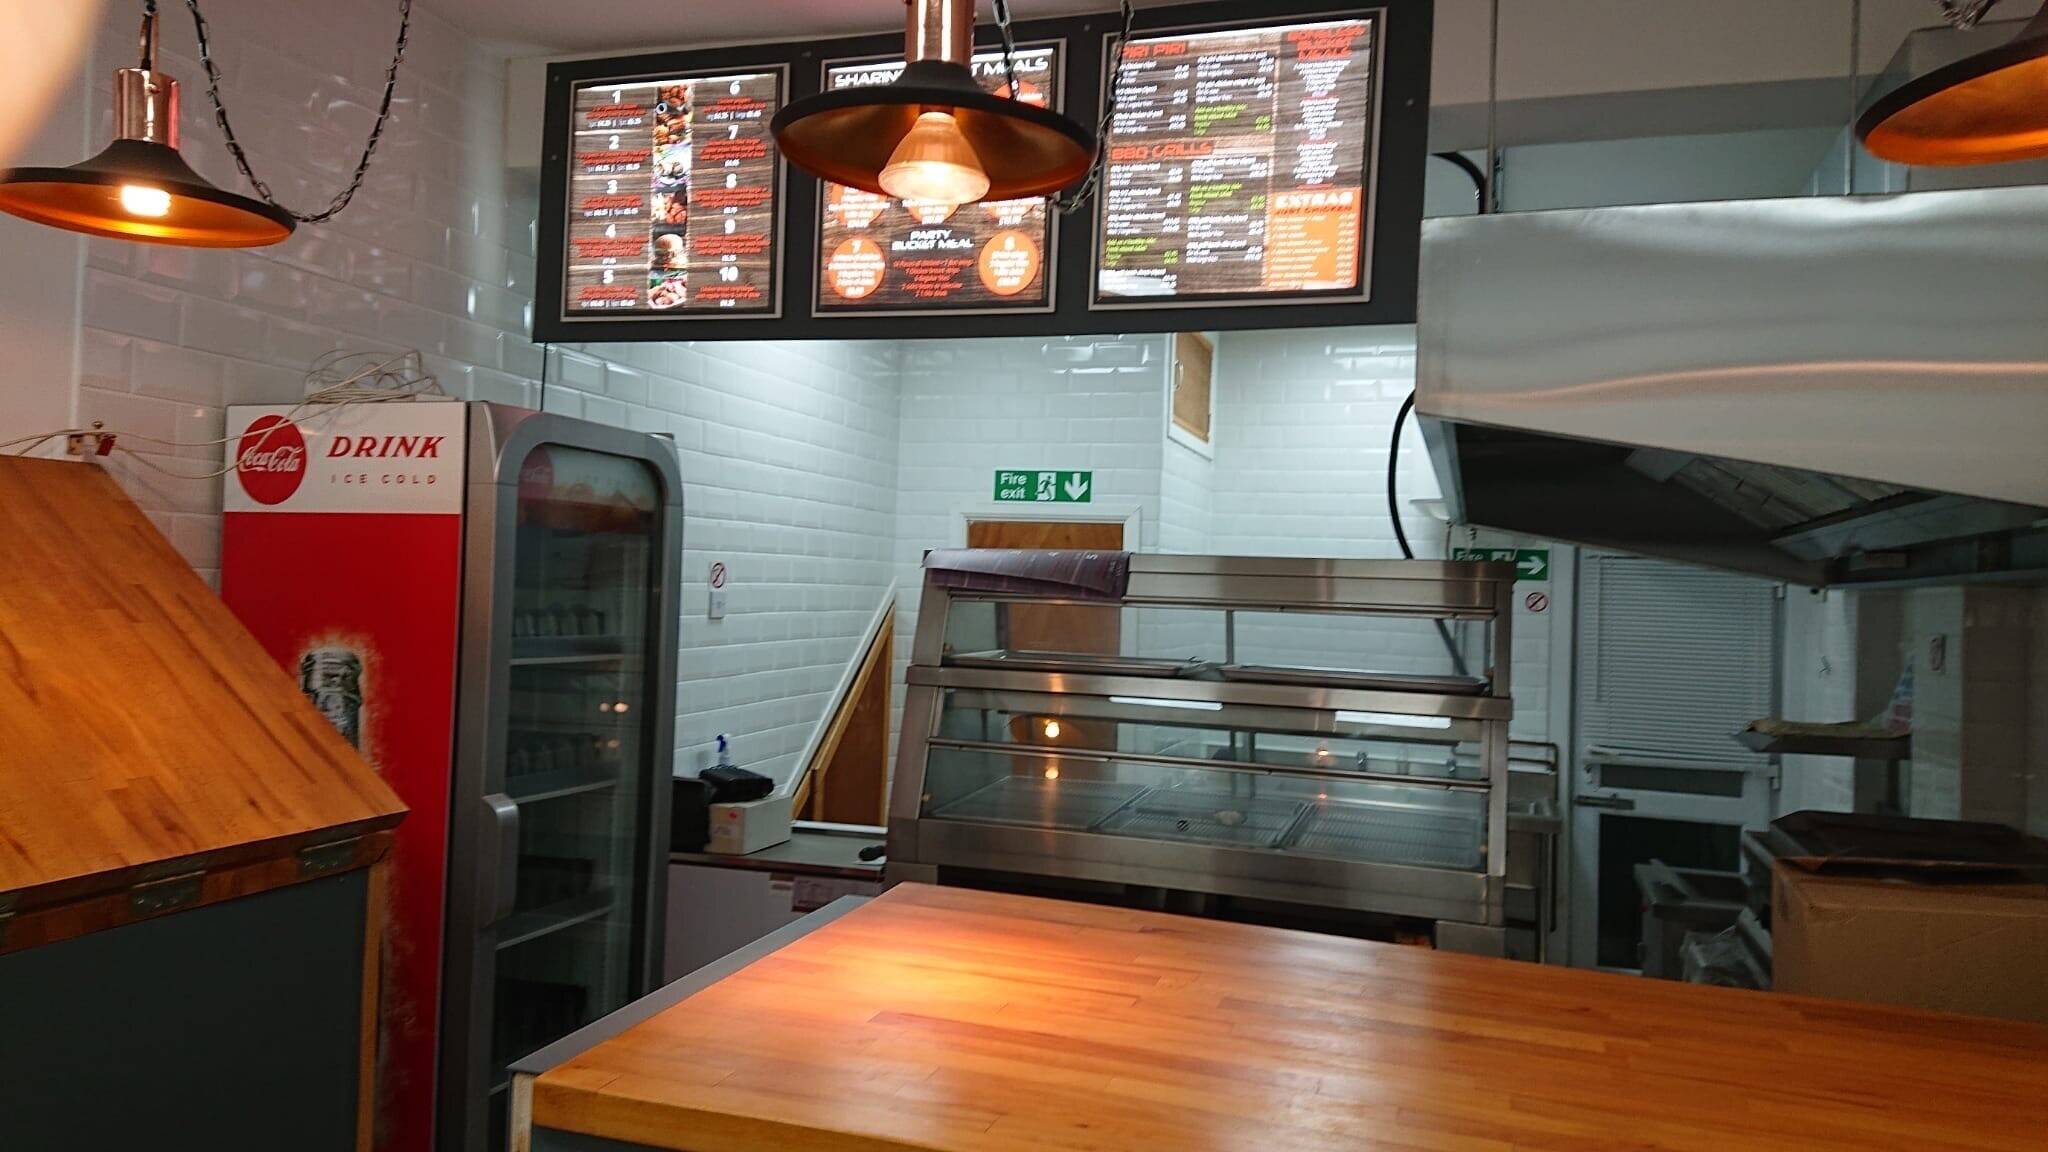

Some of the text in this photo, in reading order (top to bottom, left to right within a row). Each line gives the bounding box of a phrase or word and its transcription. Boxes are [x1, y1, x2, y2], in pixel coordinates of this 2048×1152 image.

[1154, 43, 1185, 55] PIRI
[834, 69, 904, 88] SHARIN
[730, 80, 741, 95] 6
[612, 90, 621, 103] 1
[728, 124, 739, 139] 7
[609, 136, 619, 150] 2
[1152, 142, 1213, 158] GRILLS
[607, 180, 618, 194] 3
[726, 173, 737, 188] 8
[1275, 192, 1354, 208] EXTRAS
[605, 223, 616, 238] 4
[725, 219, 736, 234] 9
[910, 230, 952, 240] PARTY
[938, 239, 974, 249] MEAL
[603, 270, 614, 284] 5
[719, 267, 739, 281] 10
[327, 436, 447, 458] DRINK
[239, 445, 304, 473] Coca-Cola
[330, 474, 438, 485] ICE COLD
[1000, 472, 1027, 485] Fire
[1000, 486, 1026, 499] exit
[1456, 550, 1485, 561] Fre
